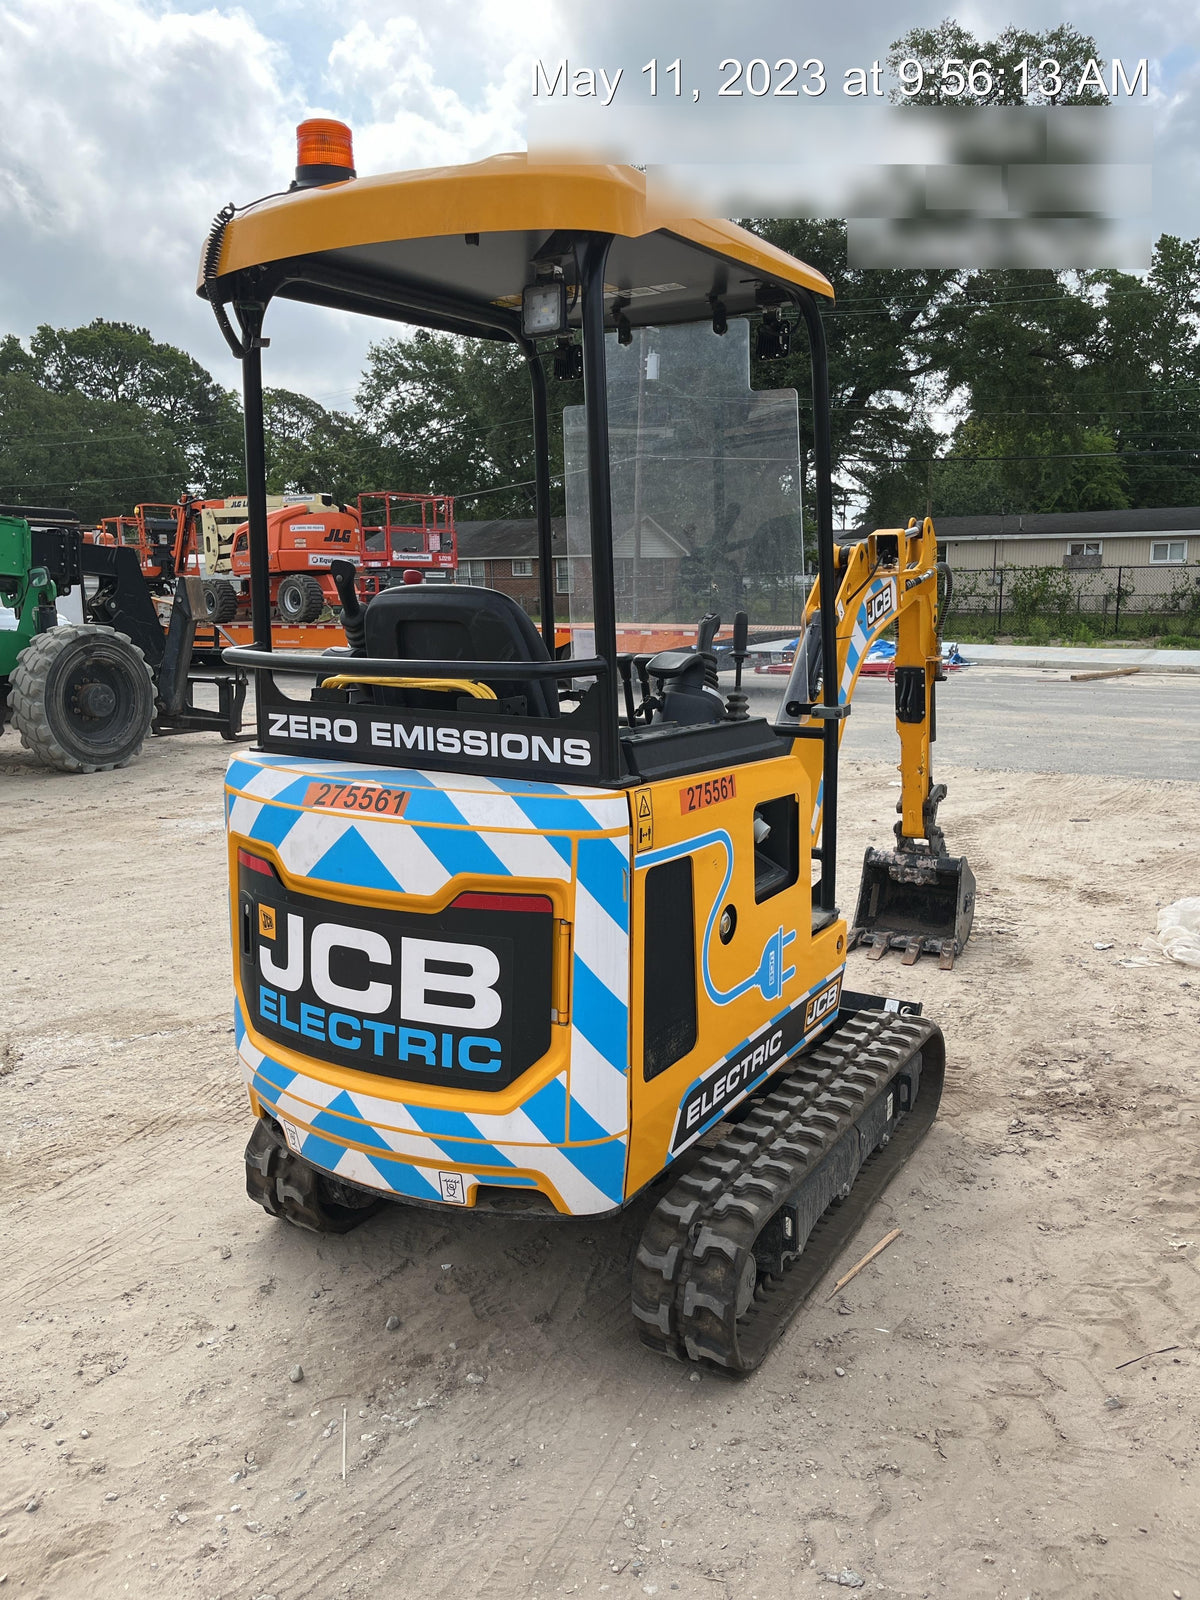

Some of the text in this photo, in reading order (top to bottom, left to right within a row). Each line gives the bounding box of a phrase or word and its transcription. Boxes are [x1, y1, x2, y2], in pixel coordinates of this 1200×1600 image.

[324, 529, 352, 544] JLG
[867, 587, 892, 624] JCB
[268, 713, 591, 767] ZERO EMISSIONS
[314, 783, 406, 814] 275561
[687, 775, 735, 811] 275561
[258, 912, 503, 1030] JCB
[806, 984, 838, 1026] JCB
[258, 984, 503, 1074] ELECTRIC
[686, 1029, 783, 1129] ELECTRIC
